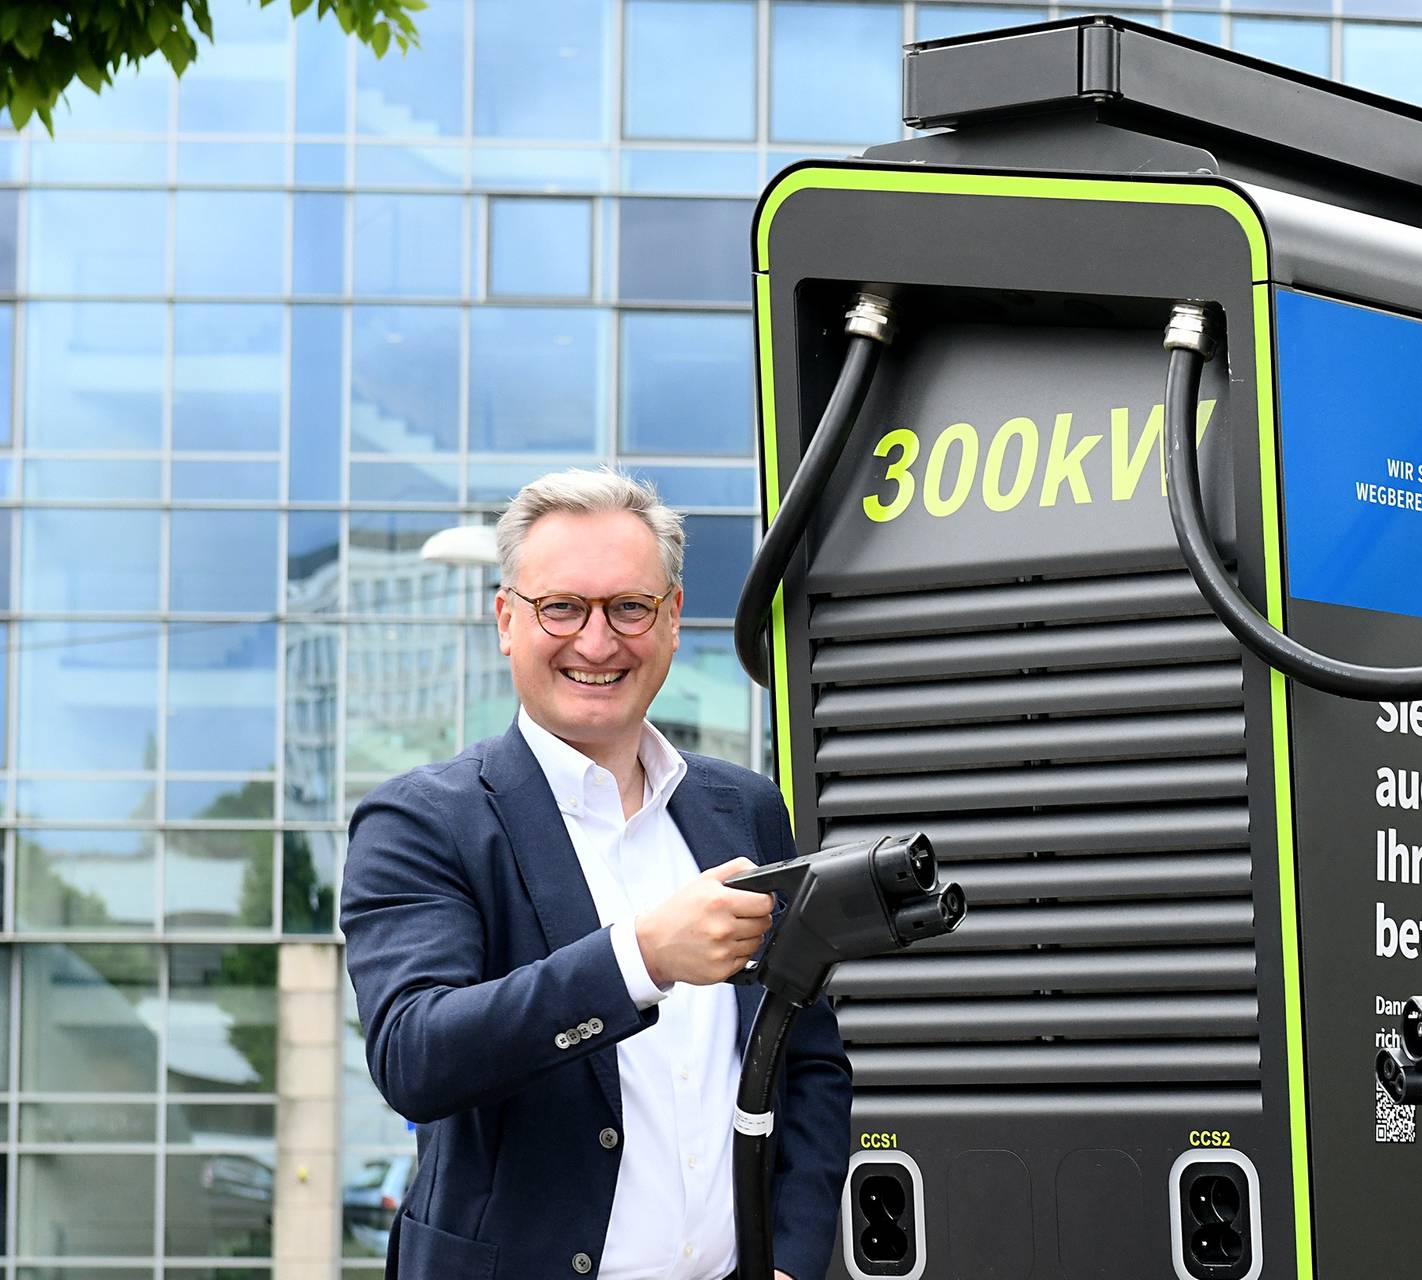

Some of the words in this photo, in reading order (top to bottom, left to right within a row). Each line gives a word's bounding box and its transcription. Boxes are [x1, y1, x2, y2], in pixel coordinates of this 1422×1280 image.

[1387, 458, 1414, 481] WIR
[1375, 1027, 1402, 1048] rich
[860, 1133, 897, 1148] CCS1
[1189, 1131, 1231, 1147] CCS2
